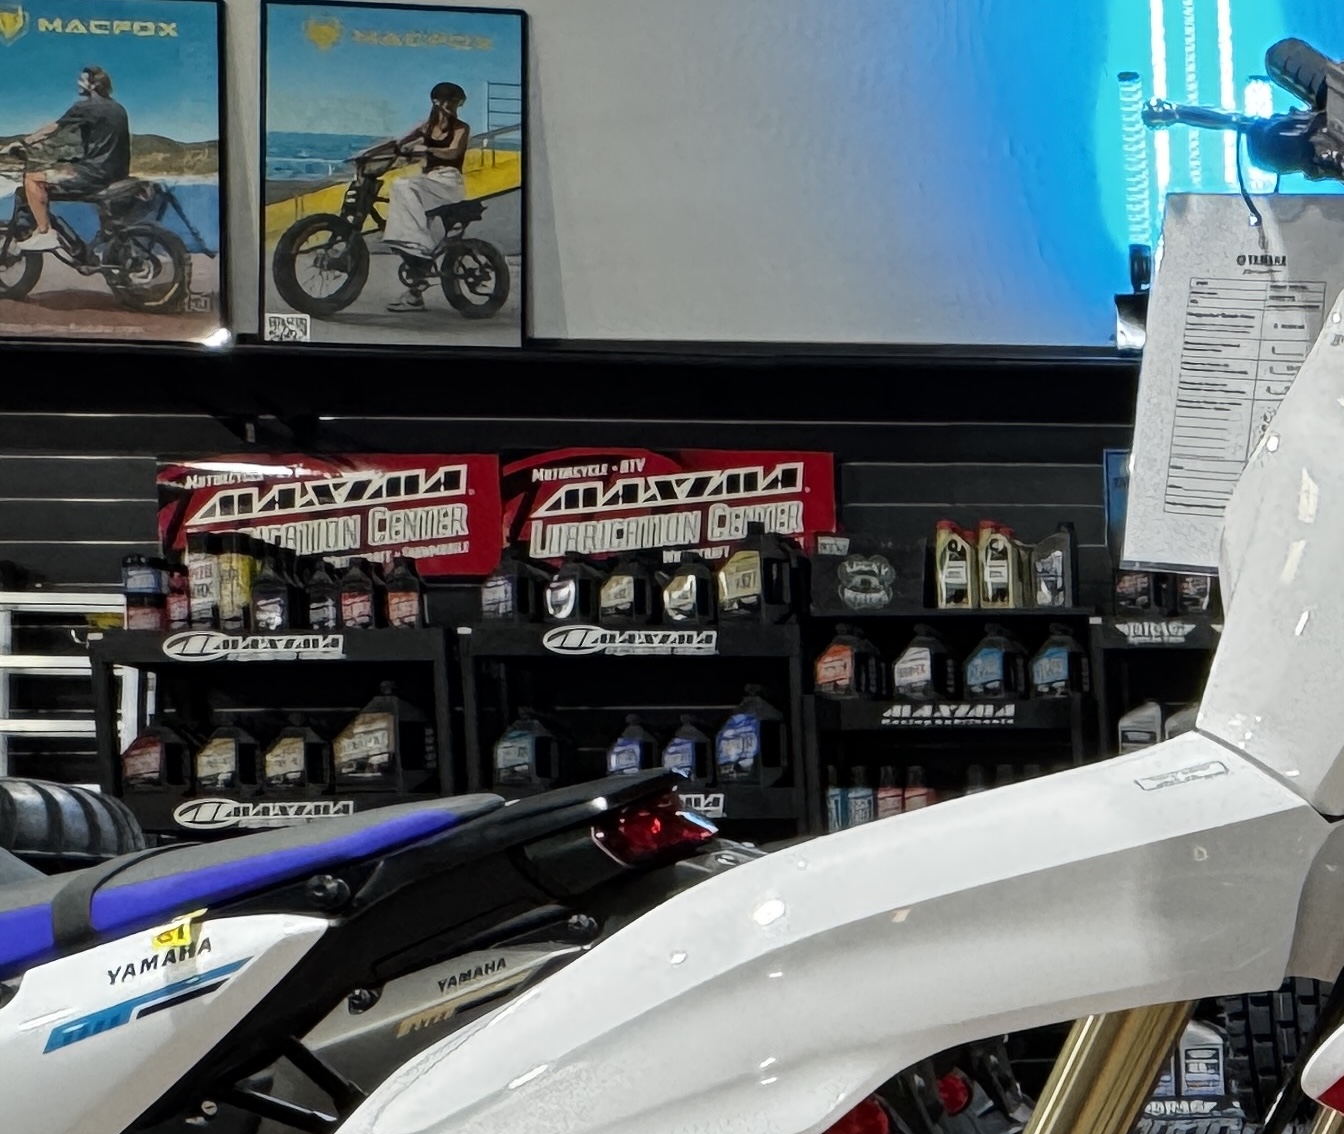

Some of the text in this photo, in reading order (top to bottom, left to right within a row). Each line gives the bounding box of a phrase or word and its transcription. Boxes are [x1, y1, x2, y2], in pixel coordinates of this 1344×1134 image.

[38, 18, 178, 37] MACFOX
[184, 464, 467, 526] MAXIMA
[531, 462, 804, 518] MAXIMA
[368, 503, 469, 546] CENTER
[883, 704, 1015, 717] MAXIMA
[107, 937, 212, 985] YAMAHA
[438, 957, 506, 993] YAMAHA
